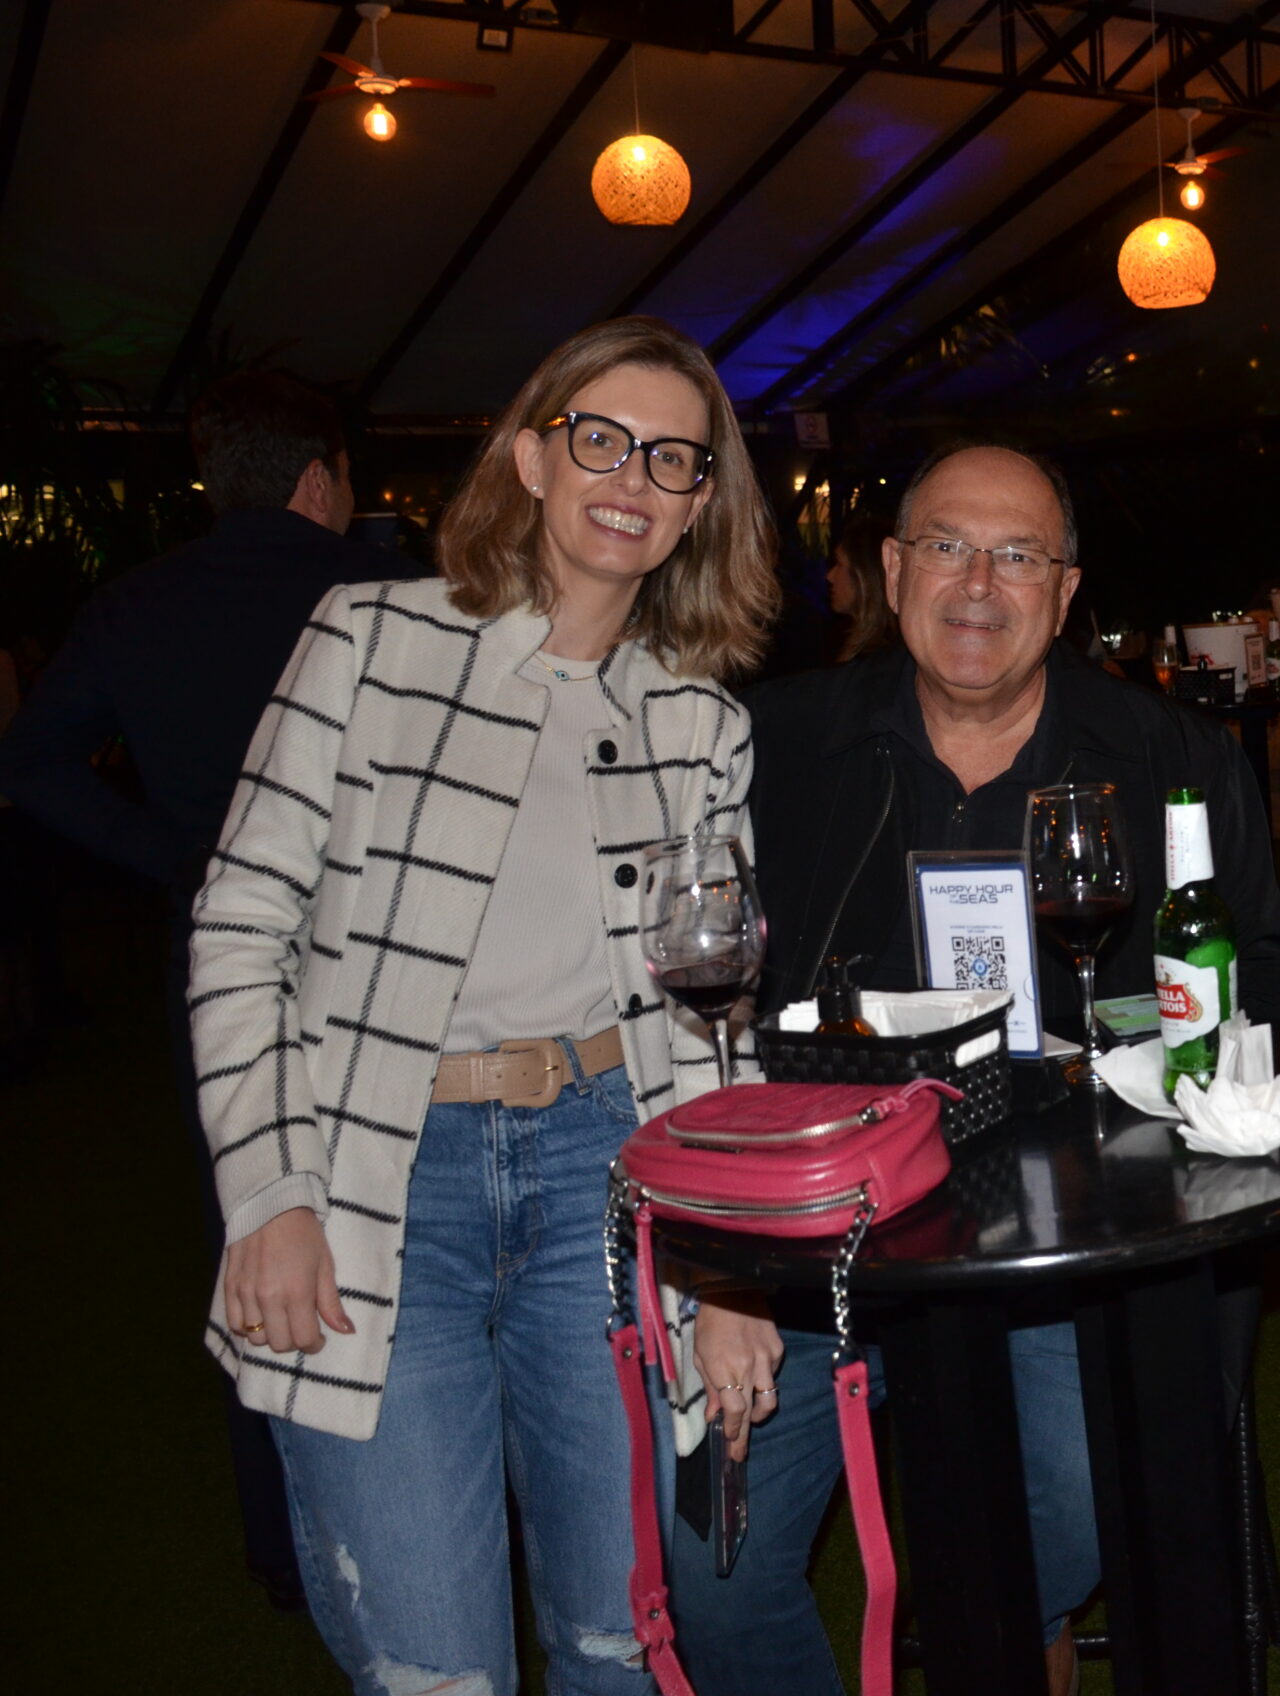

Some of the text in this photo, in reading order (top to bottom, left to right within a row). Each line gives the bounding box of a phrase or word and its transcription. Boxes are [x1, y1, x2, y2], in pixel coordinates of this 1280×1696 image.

[929, 884, 1013, 895] HAPPY HOUR
[959, 893, 998, 904] SEAS
